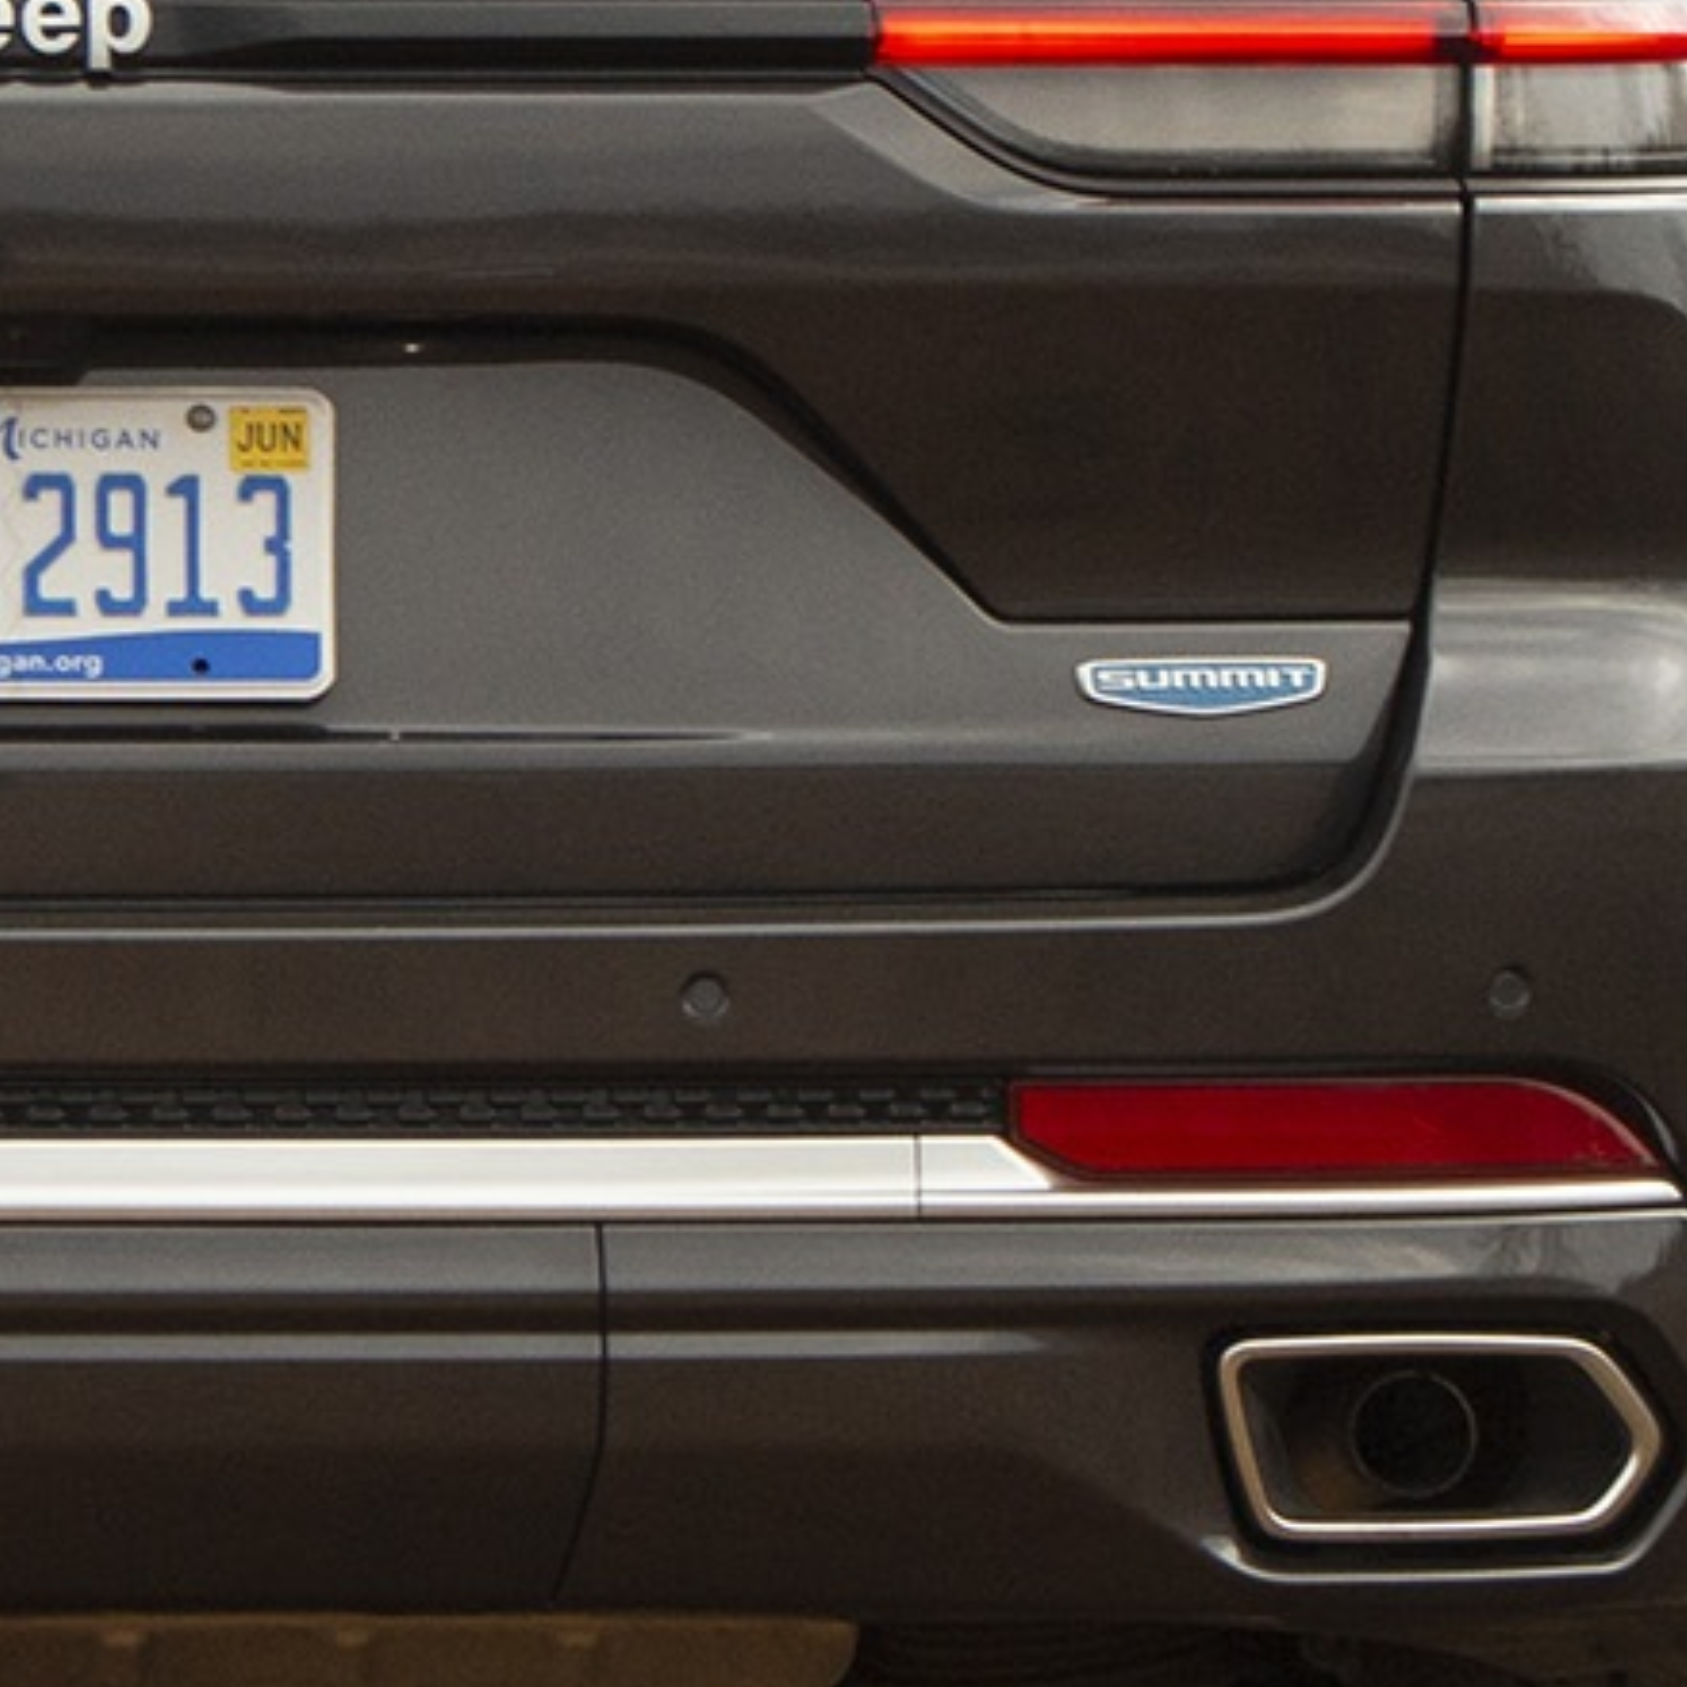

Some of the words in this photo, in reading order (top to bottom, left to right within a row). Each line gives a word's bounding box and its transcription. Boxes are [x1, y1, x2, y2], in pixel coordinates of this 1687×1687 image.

[236, 421, 303, 453] JUN
[22, 472, 292, 616] 2913
[1097, 667, 1313, 690] SUMMIT
